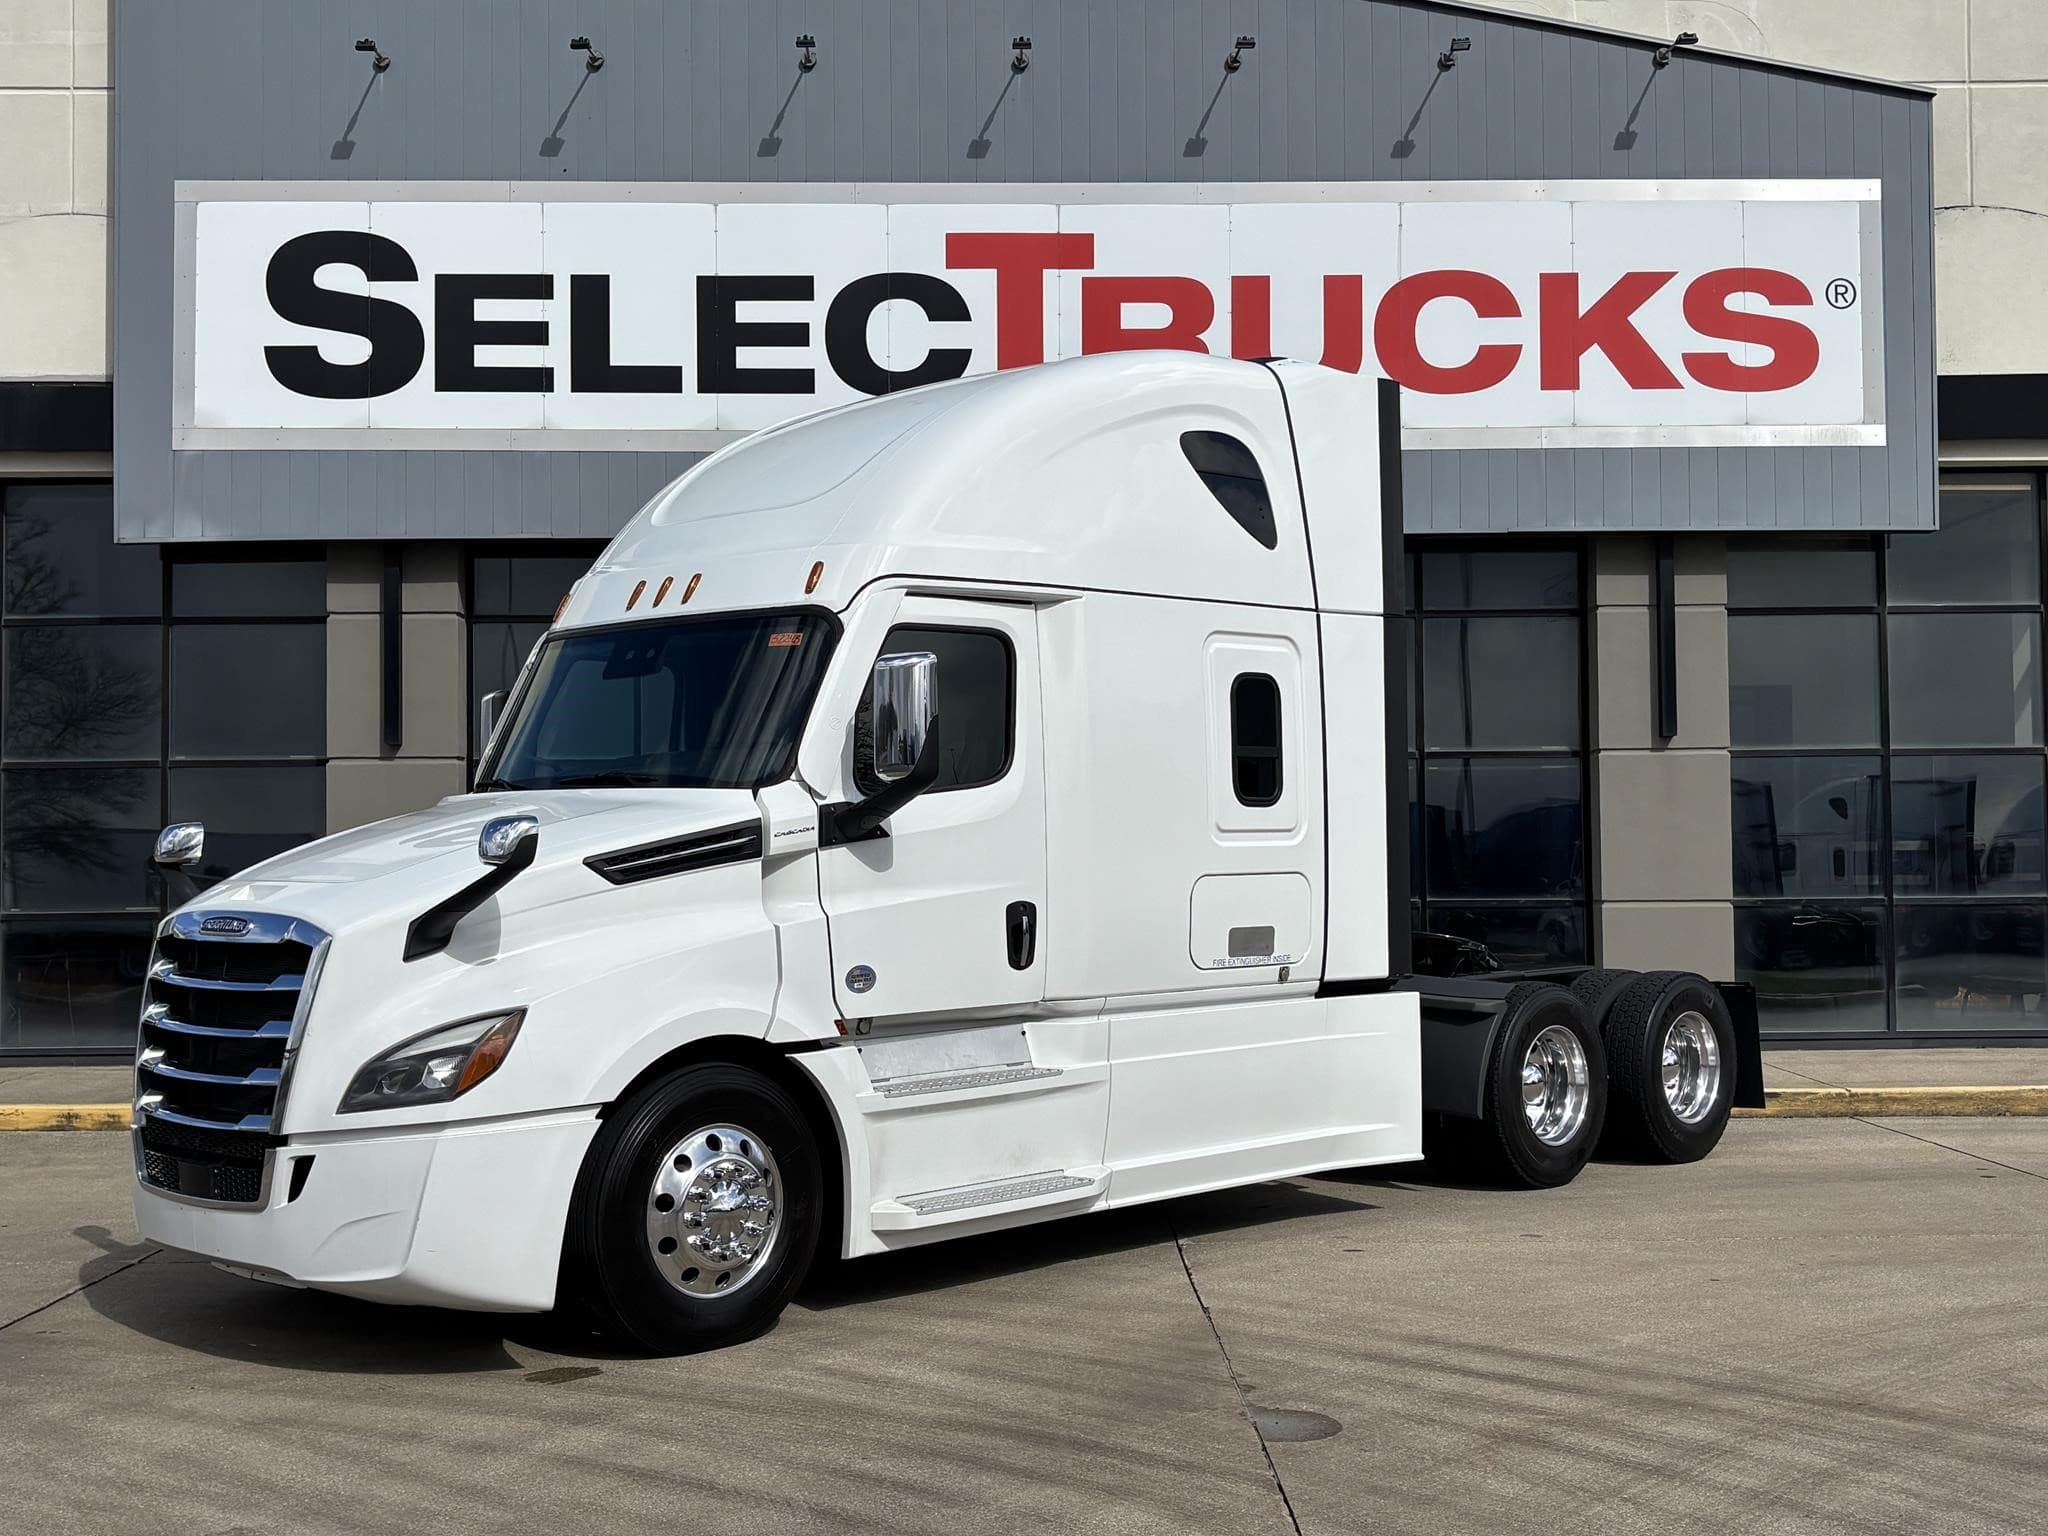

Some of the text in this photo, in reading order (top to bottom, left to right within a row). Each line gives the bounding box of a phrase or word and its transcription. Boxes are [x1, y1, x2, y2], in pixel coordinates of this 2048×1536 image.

[1212, 954, 1291, 967] FIRE EXTINGUISHER INSIDE
